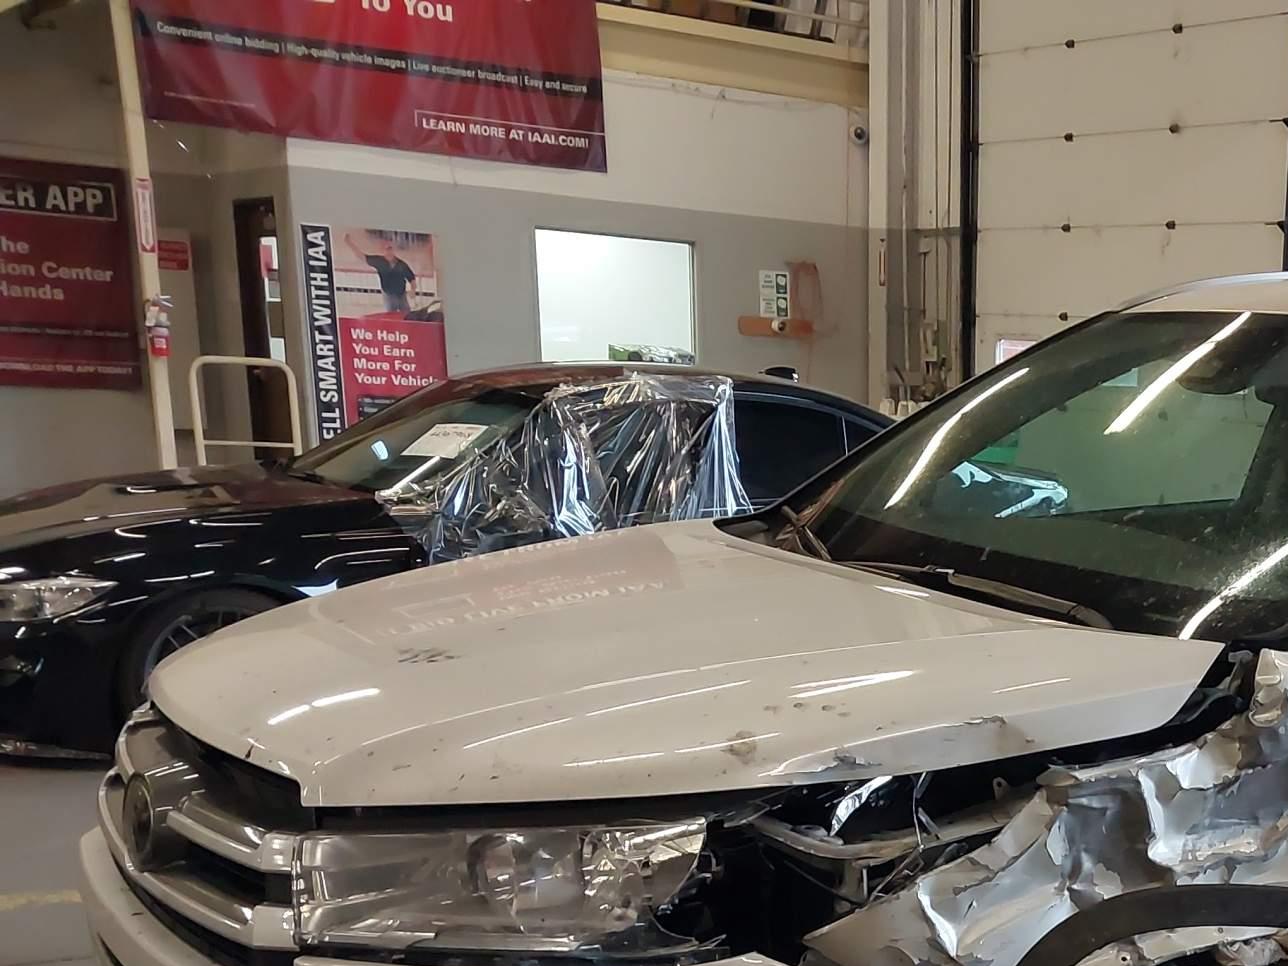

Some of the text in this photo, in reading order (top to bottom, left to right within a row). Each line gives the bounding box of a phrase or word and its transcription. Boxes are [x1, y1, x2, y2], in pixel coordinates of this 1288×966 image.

[404, 0, 453, 21] You
[157, 21, 213, 41] Convenient
[215, 34, 243, 46] online
[245, 35, 280, 53] bidding
[286, 43, 340, 60] High-quality
[342, 51, 373, 64] vehicle
[374, 57, 406, 69] images
[413, 60, 430, 72] Live
[432, 63, 476, 79] auctioneer
[478, 68, 518, 84] broadcast
[524, 77, 543, 90] Easy
[545, 80, 561, 91] and
[562, 82, 588, 94] secure
[422, 117, 589, 148] LEARN MORE AT IAAI.COM!
[0, 182, 104, 213] ER APP
[0, 235, 30, 254] he
[0, 259, 114, 281] ion Center
[306, 230, 343, 440] ELL SMART WITH IAA
[350, 328, 409, 343] We Help
[352, 343, 415, 357] You Earn
[353, 358, 416, 372] More For
[354, 372, 387, 385] Your
